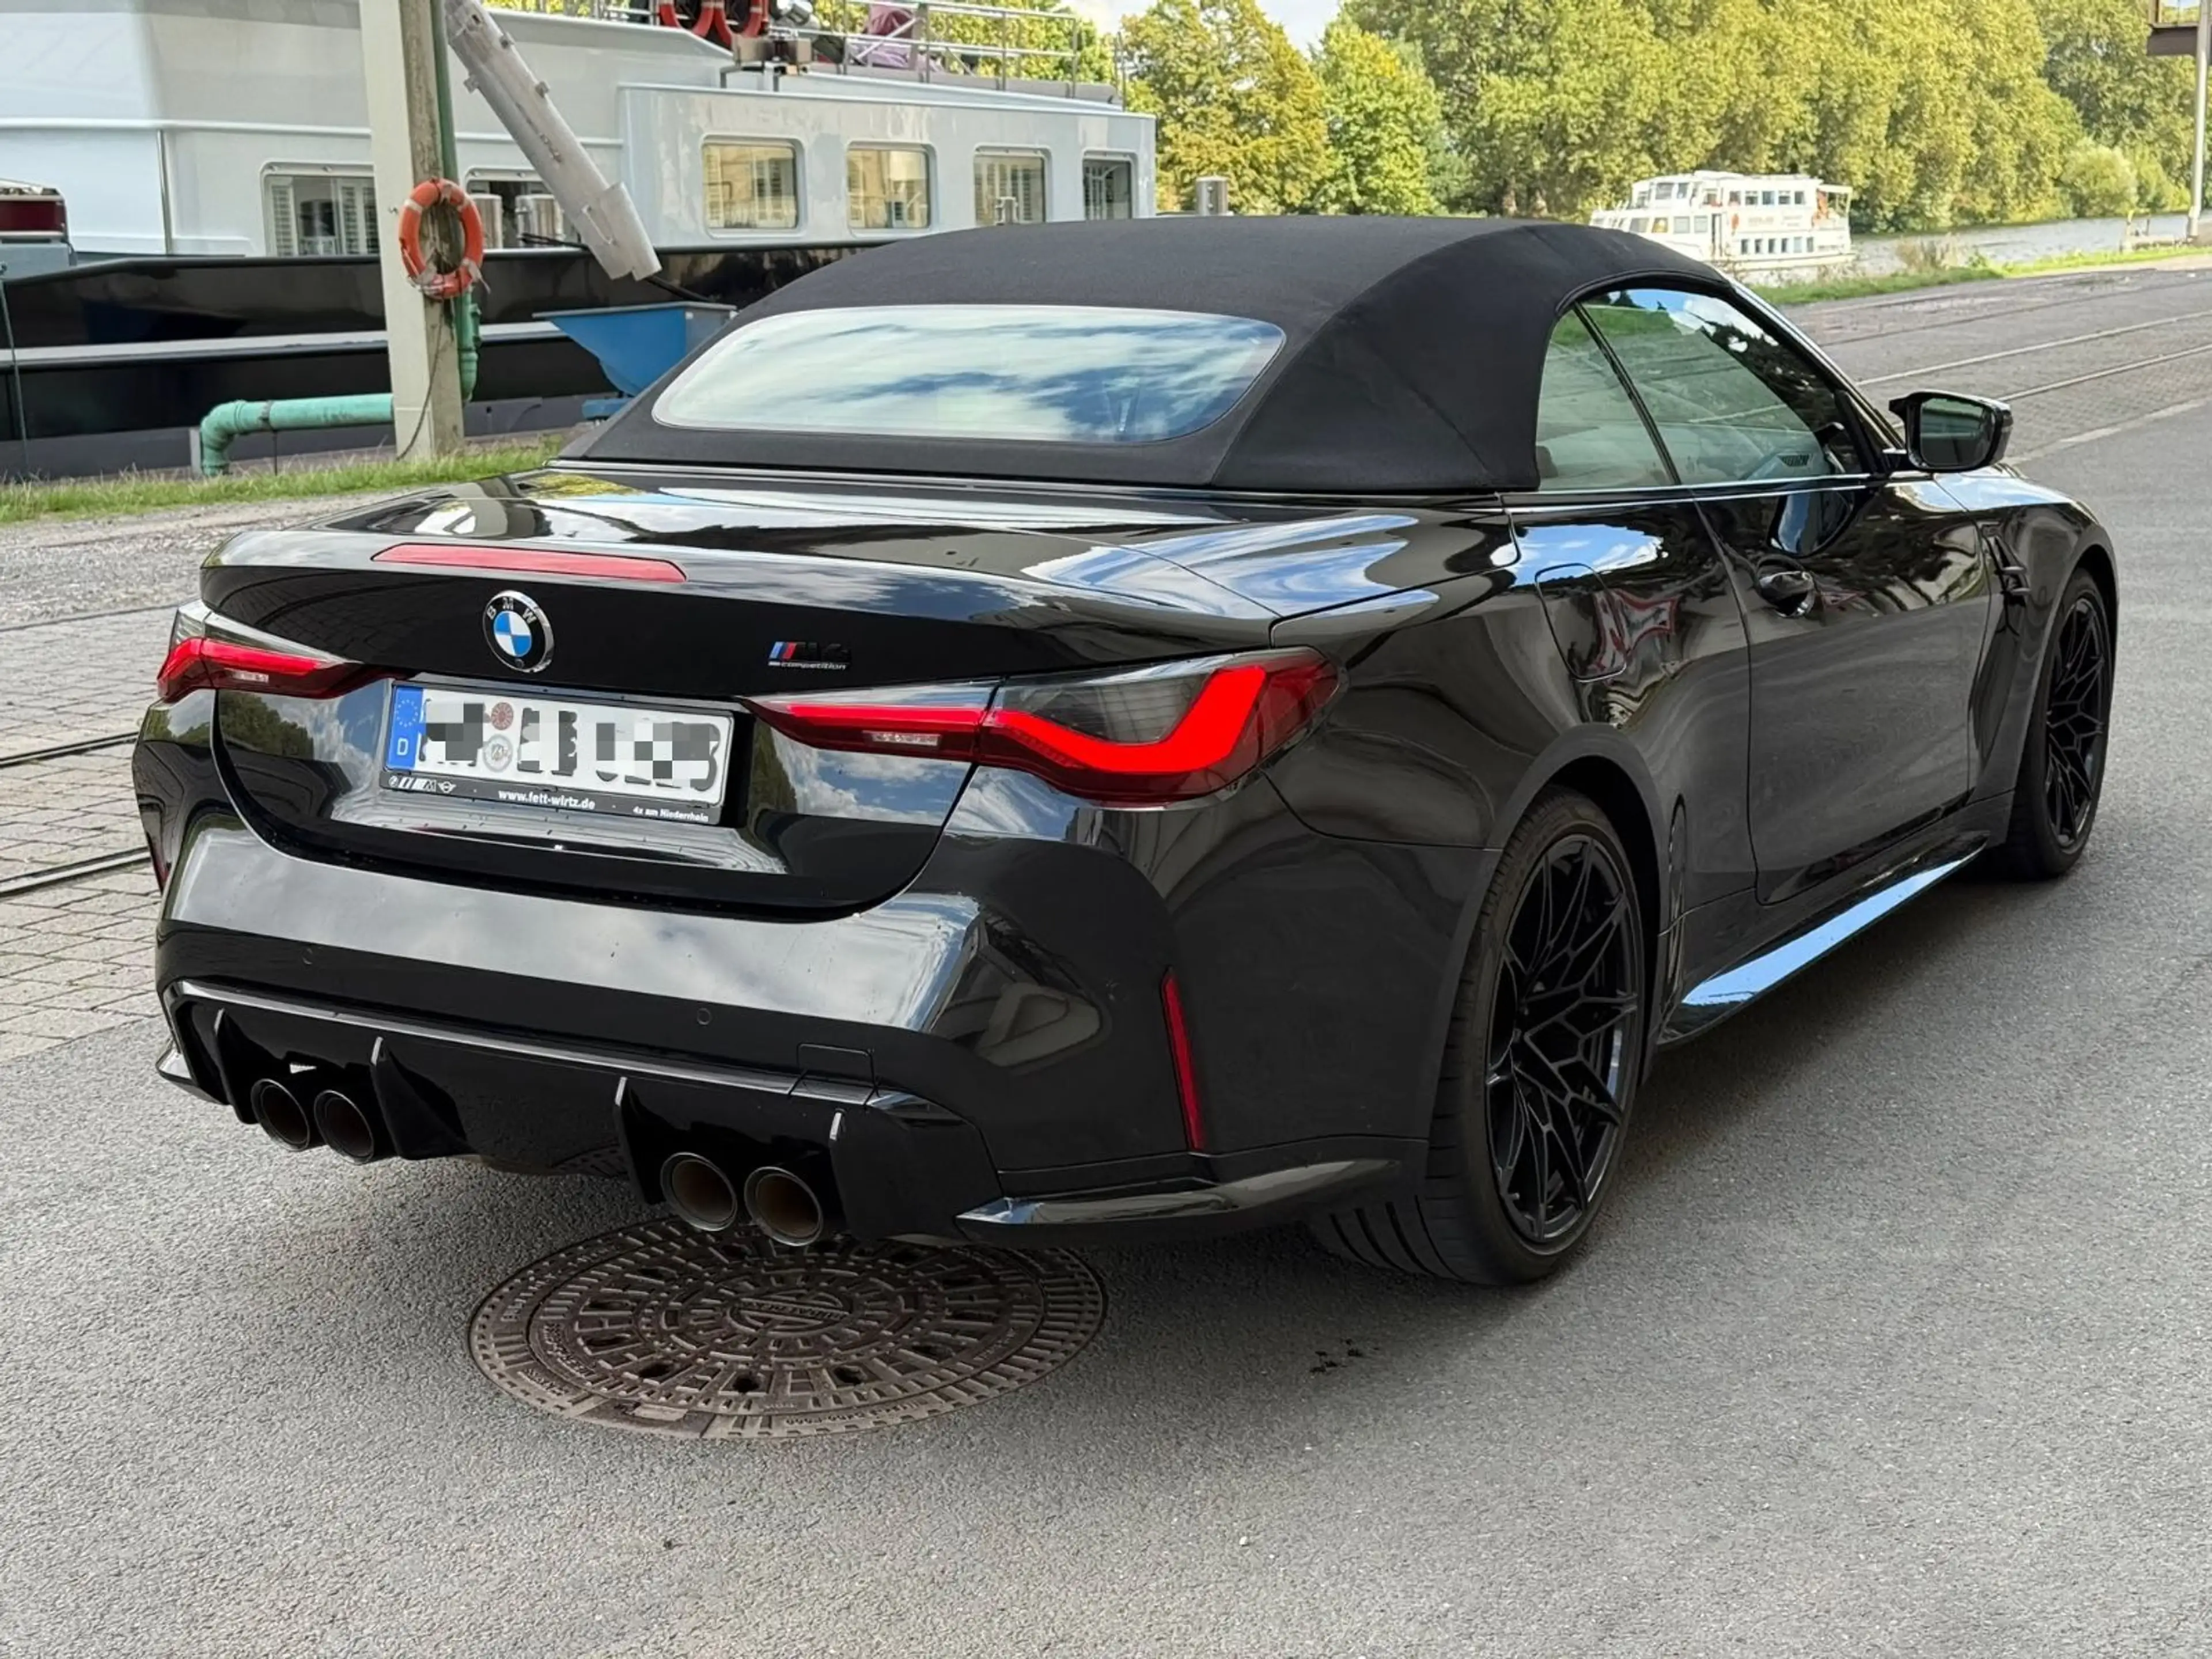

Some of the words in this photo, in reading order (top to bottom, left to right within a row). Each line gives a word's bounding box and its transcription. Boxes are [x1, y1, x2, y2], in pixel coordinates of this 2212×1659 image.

[781, 662, 846, 670] competition
[397, 737, 409, 756] D
[498, 790, 596, 810] www.fett-wirtz.de
